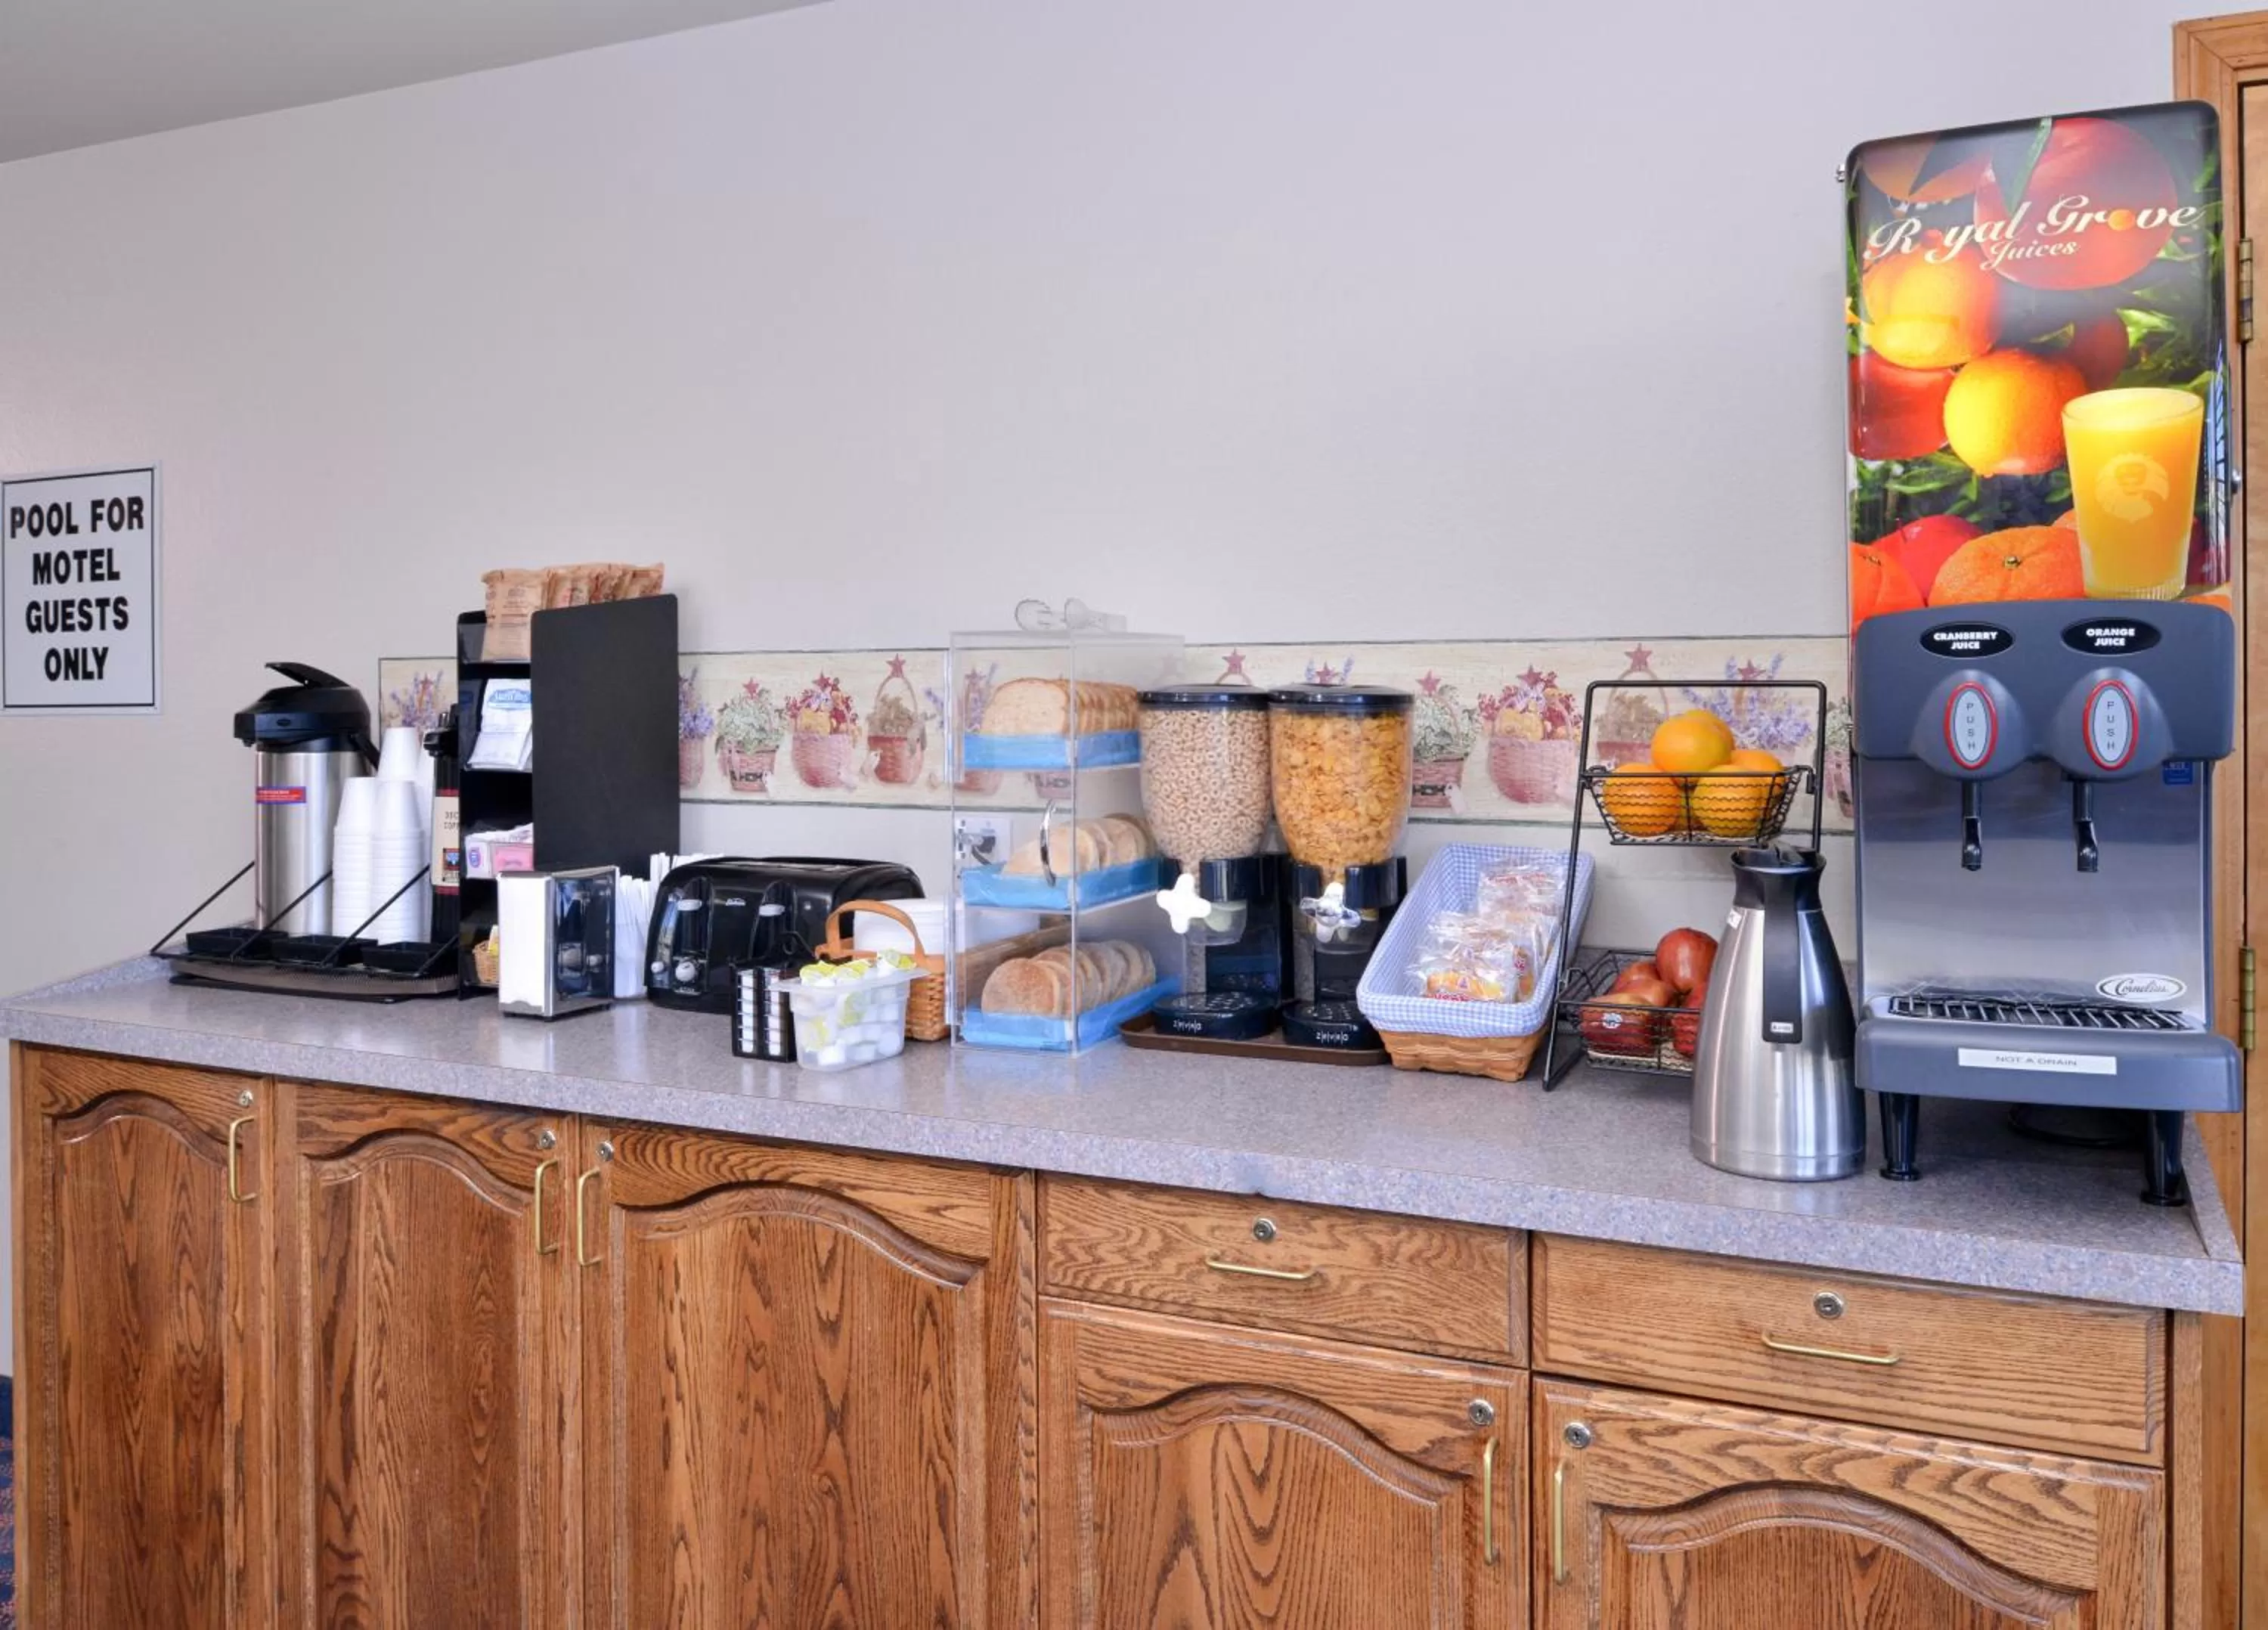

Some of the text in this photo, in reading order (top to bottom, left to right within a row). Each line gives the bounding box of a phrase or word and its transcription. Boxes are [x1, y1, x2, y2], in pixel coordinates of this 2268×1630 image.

[1980, 238, 2081, 271] Juices
[10, 496, 144, 539] POOL FOR
[33, 547, 121, 586] MOTEL
[25, 596, 129, 634] GUESTS
[1933, 631, 1998, 642] CRANBERRY
[1950, 641, 1981, 650] JUICE
[2086, 628, 2136, 637] ORANGE
[2094, 637, 2125, 647] JUICE
[44, 646, 109, 682] ONLY
[1966, 702, 1976, 750] PUSH
[2106, 701, 2116, 750] PUSH
[2037, 1058, 2077, 1068] DRAIN
